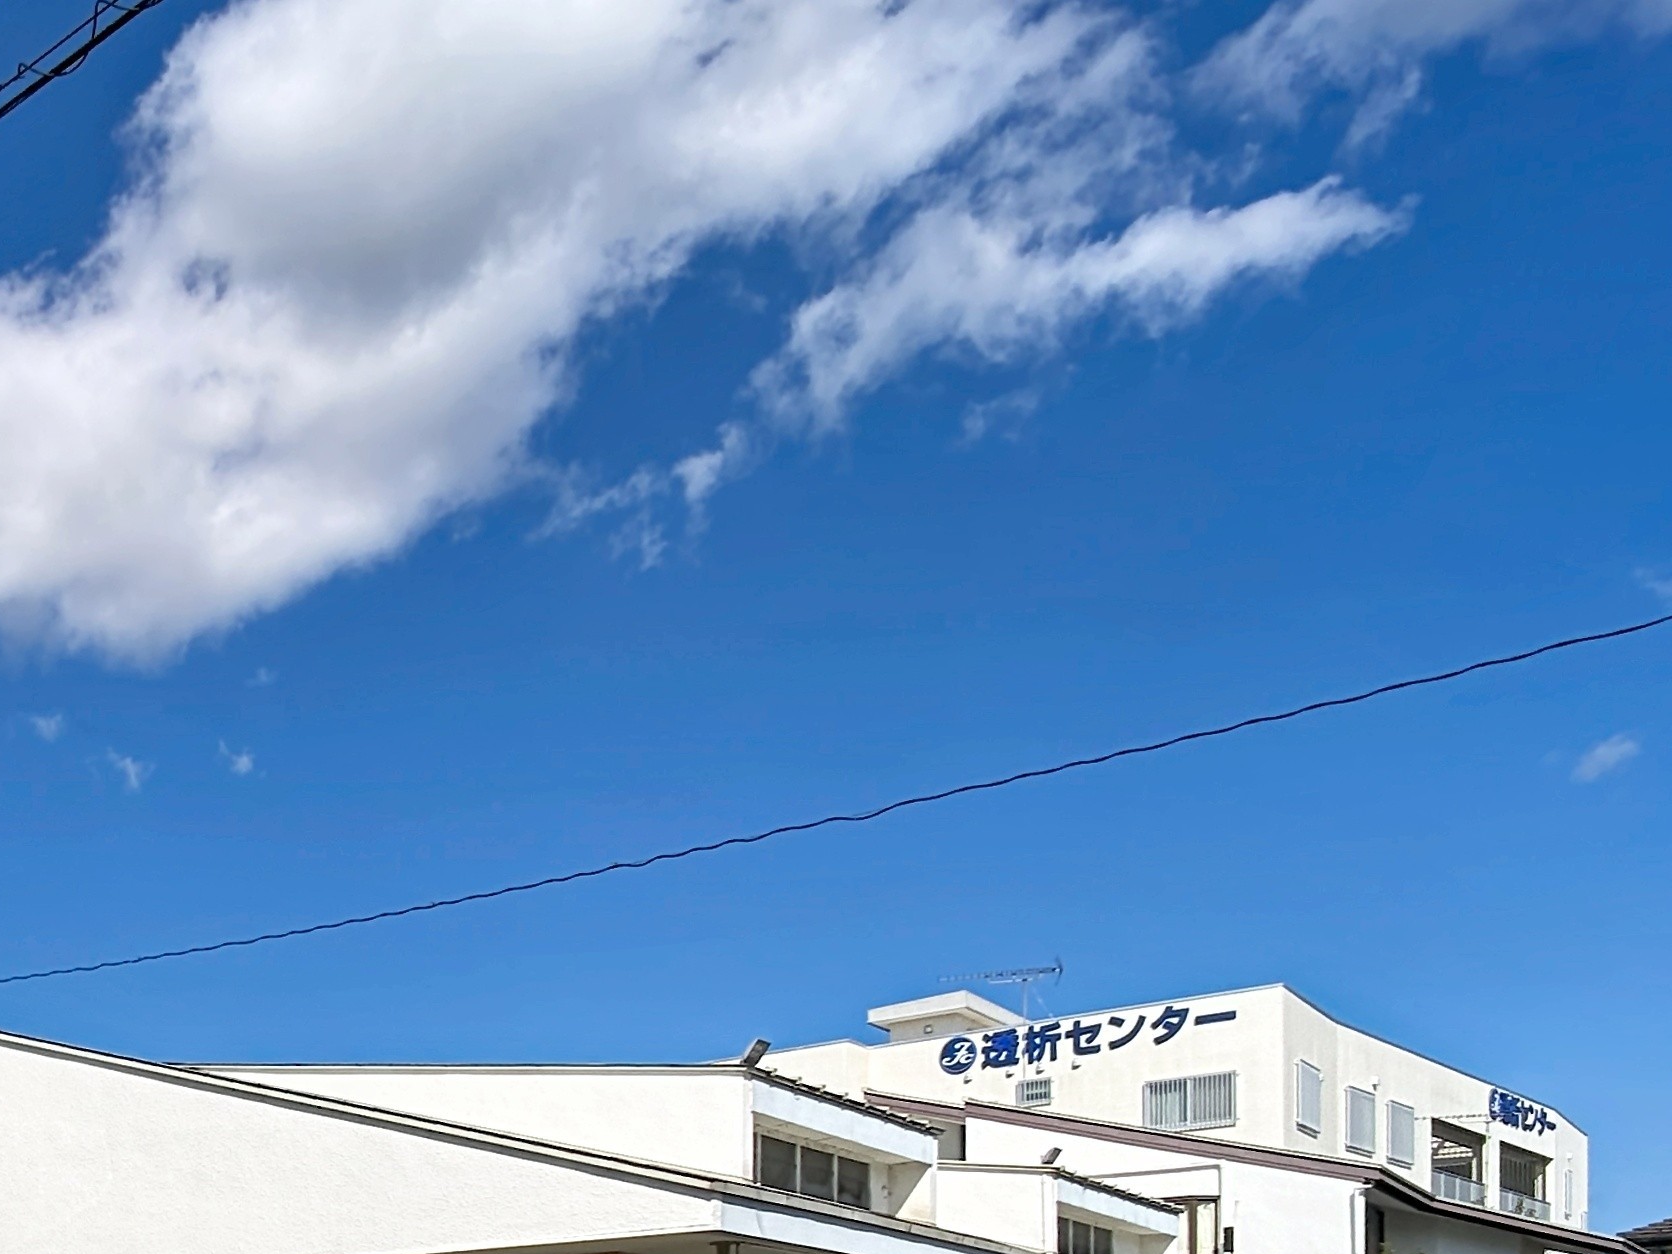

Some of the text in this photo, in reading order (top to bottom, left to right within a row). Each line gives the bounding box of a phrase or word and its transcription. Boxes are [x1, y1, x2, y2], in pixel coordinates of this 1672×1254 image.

[981, 1005, 1237, 1070] 透析センター
